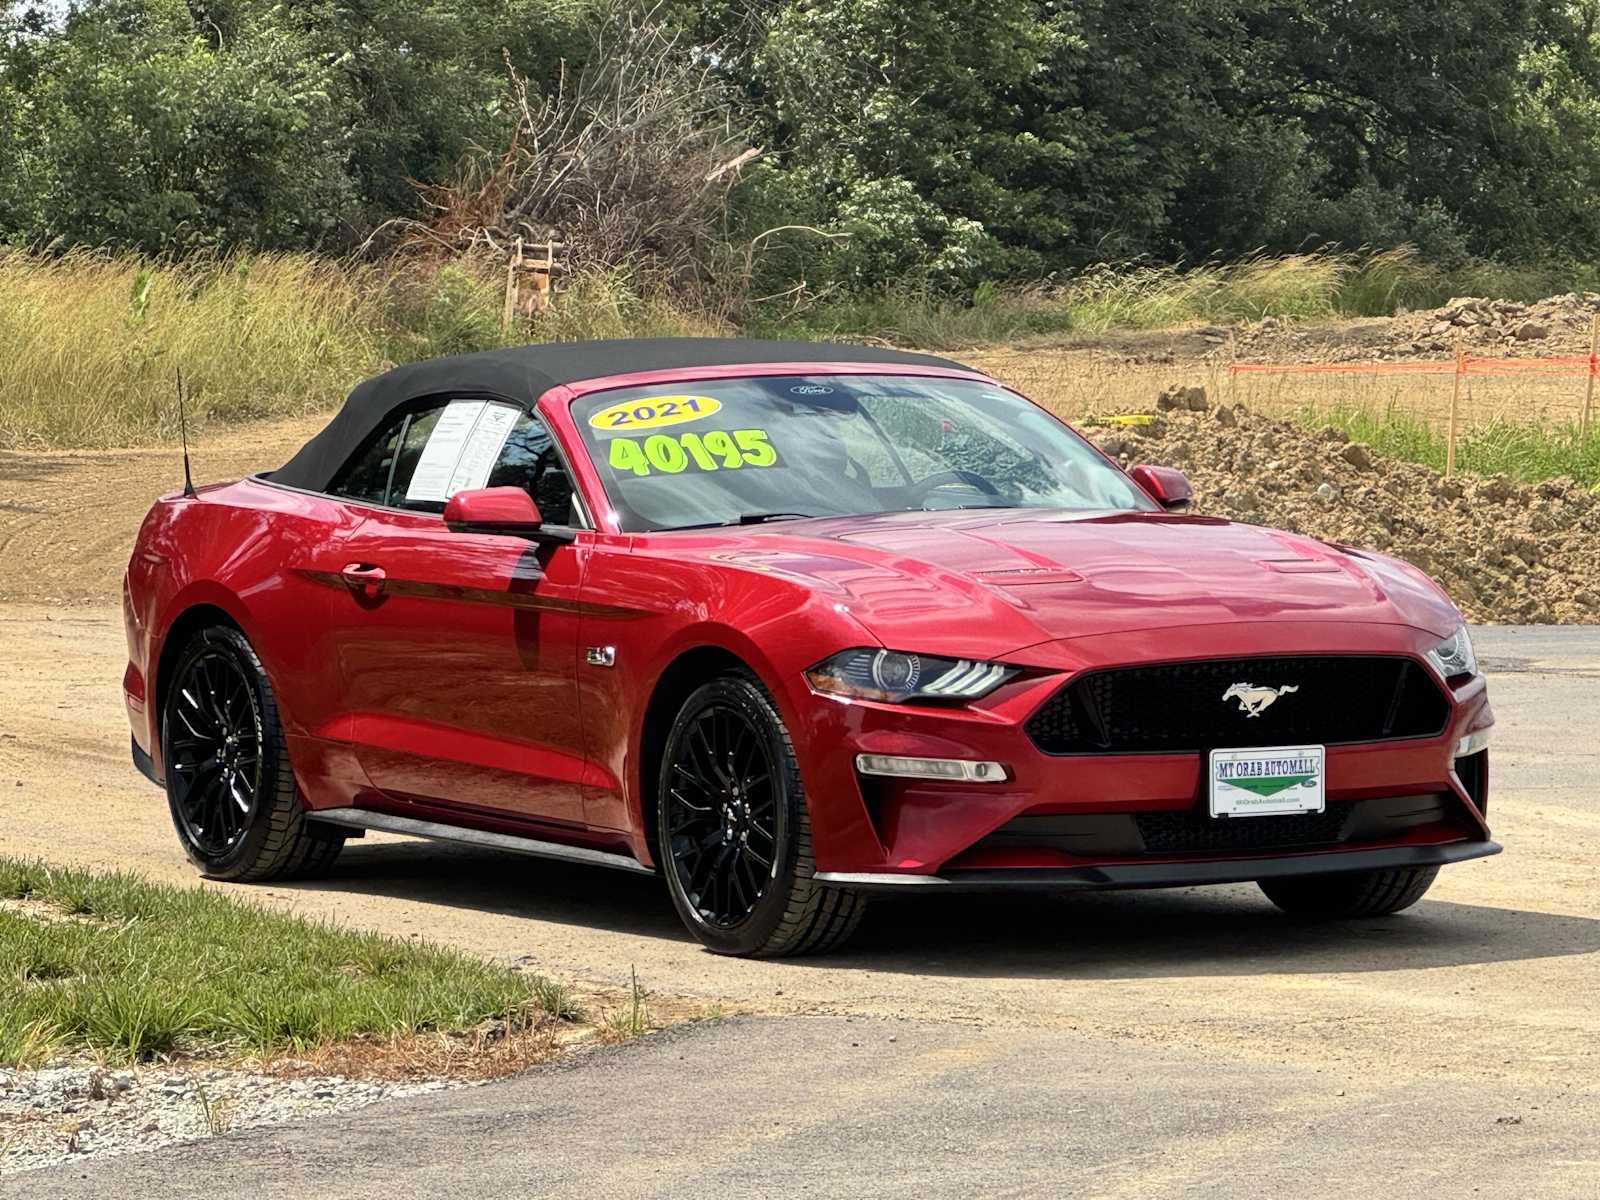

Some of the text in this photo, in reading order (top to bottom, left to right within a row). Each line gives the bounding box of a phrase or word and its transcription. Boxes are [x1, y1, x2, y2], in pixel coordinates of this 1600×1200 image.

[607, 399, 701, 426] 2021
[609, 429, 777, 476] 40195
[1219, 759, 1315, 778] MT ORAB AUTOMALL
